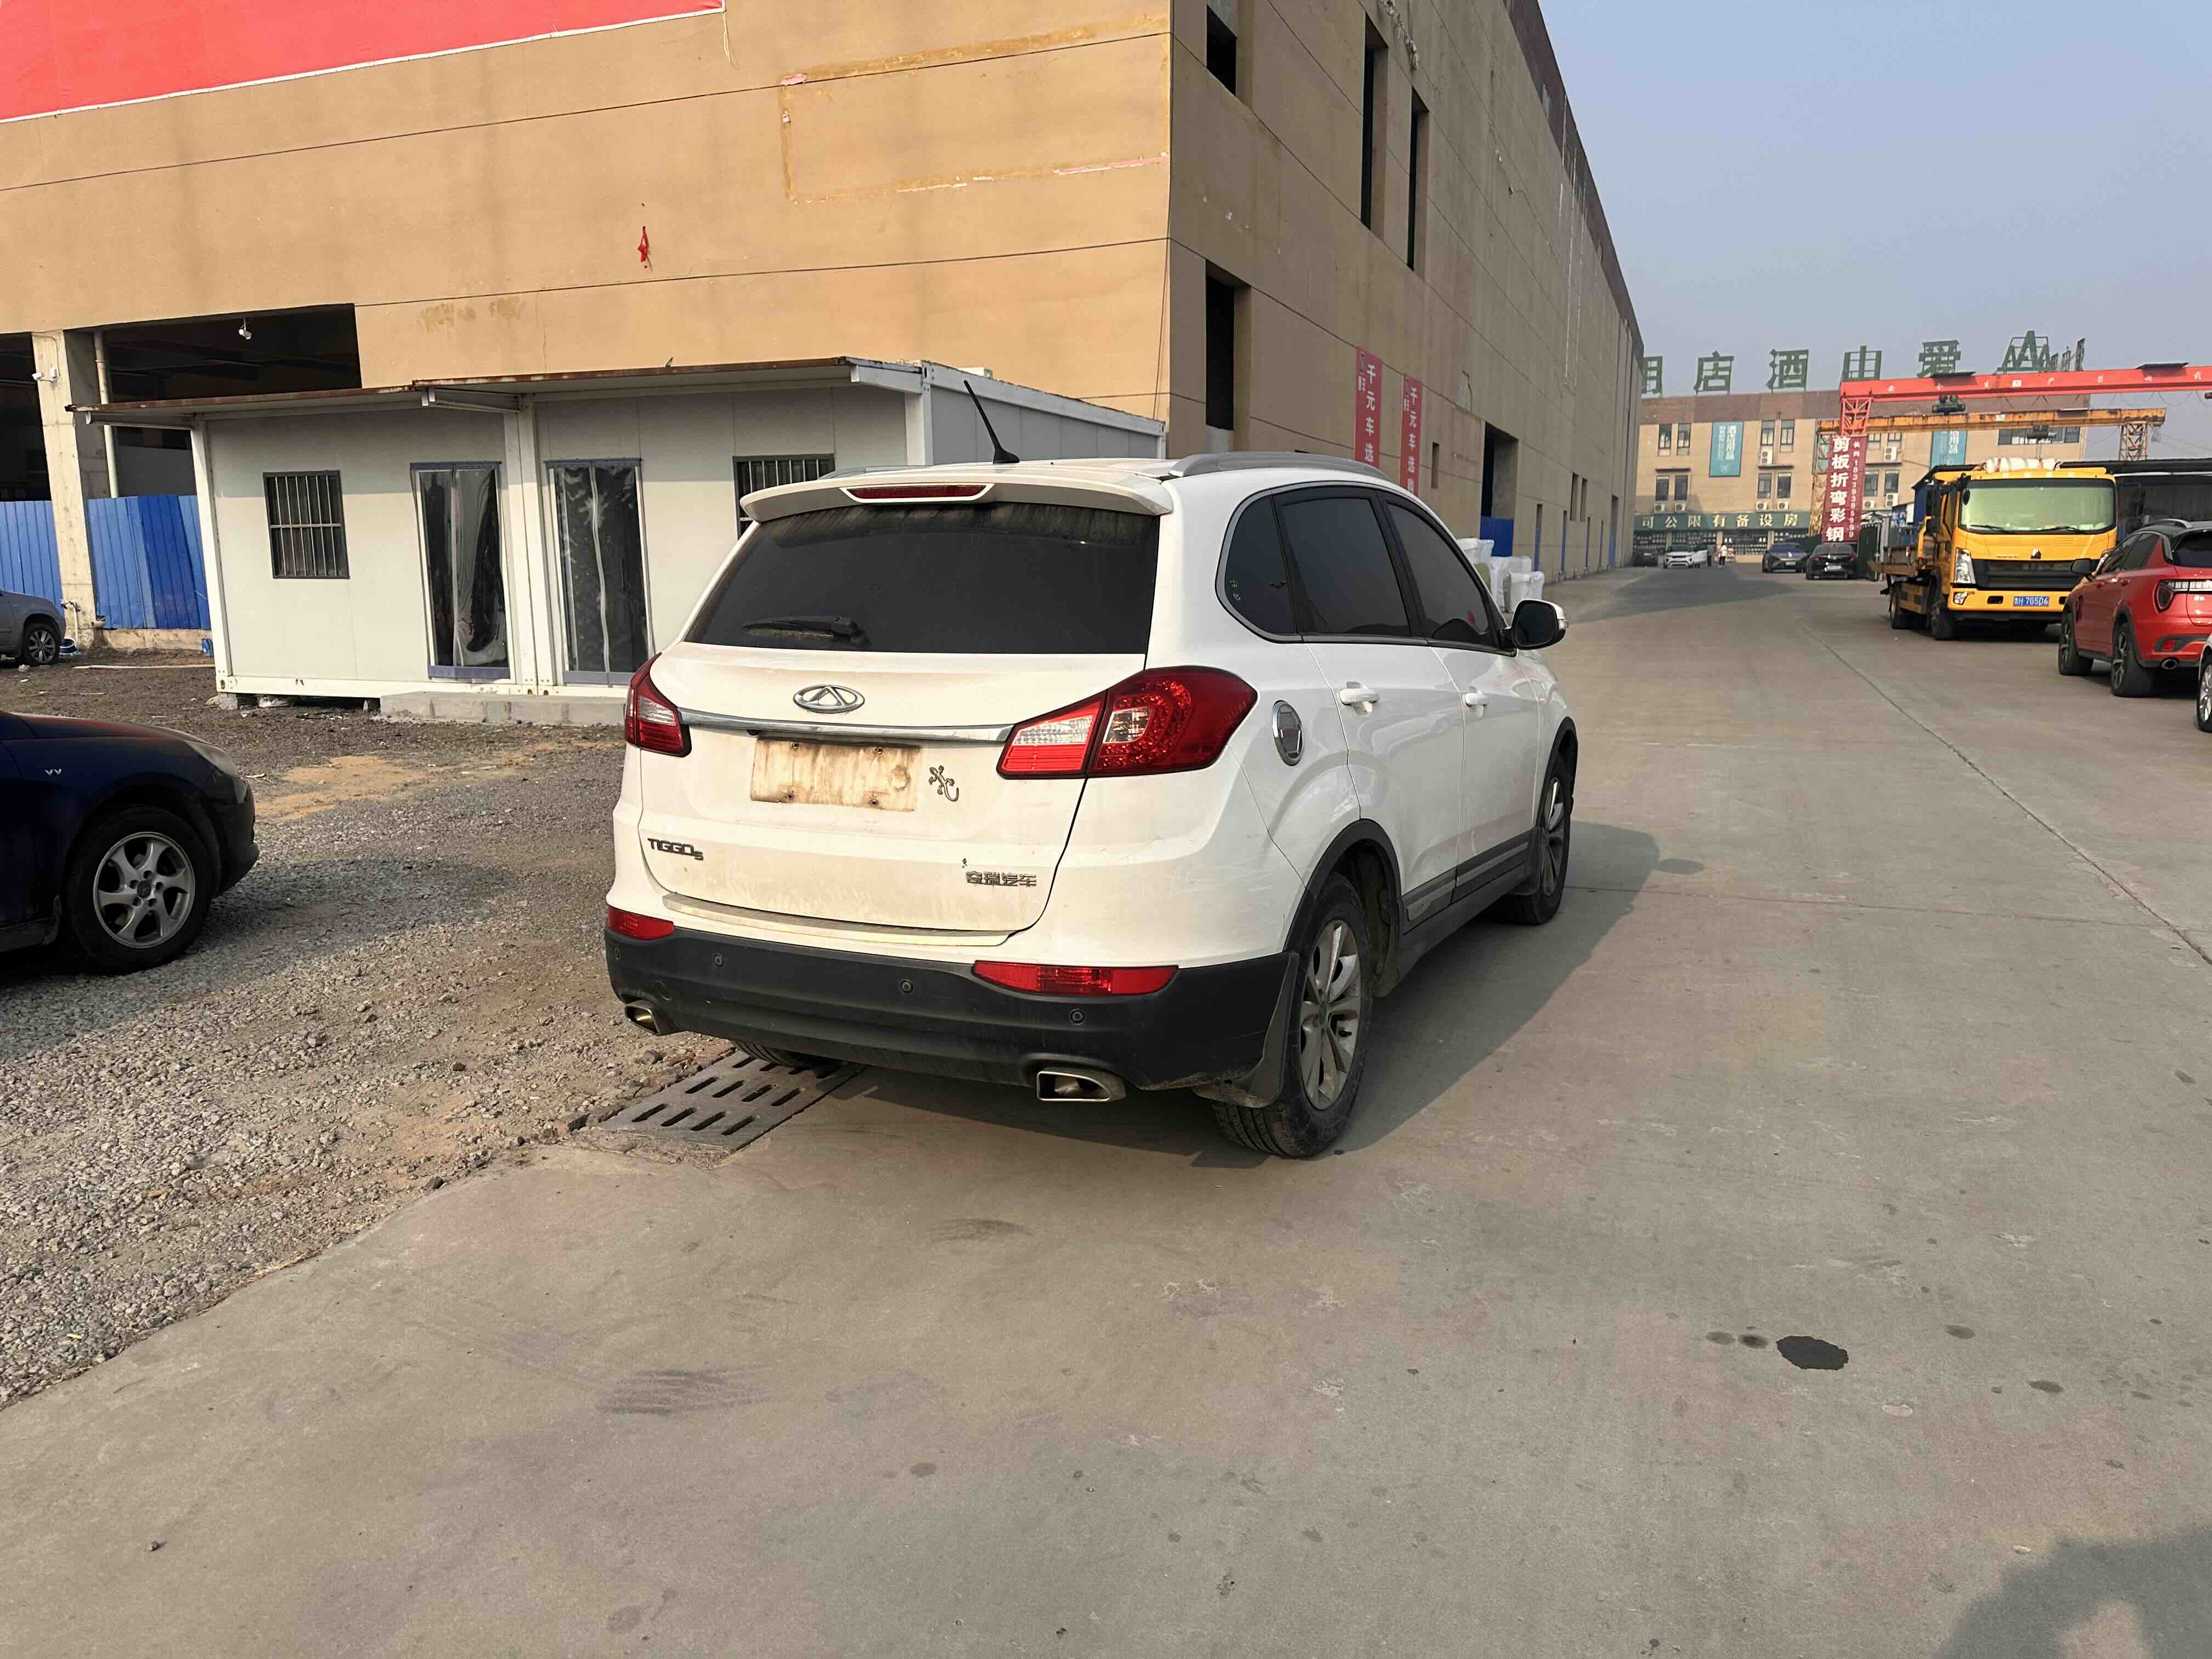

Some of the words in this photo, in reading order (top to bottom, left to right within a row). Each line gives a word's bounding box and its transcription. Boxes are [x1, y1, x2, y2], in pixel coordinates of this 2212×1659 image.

[1826, 436, 1851, 541] 剪板折弯彩钢
[965, 870, 1037, 887] 奇瑞汽车
